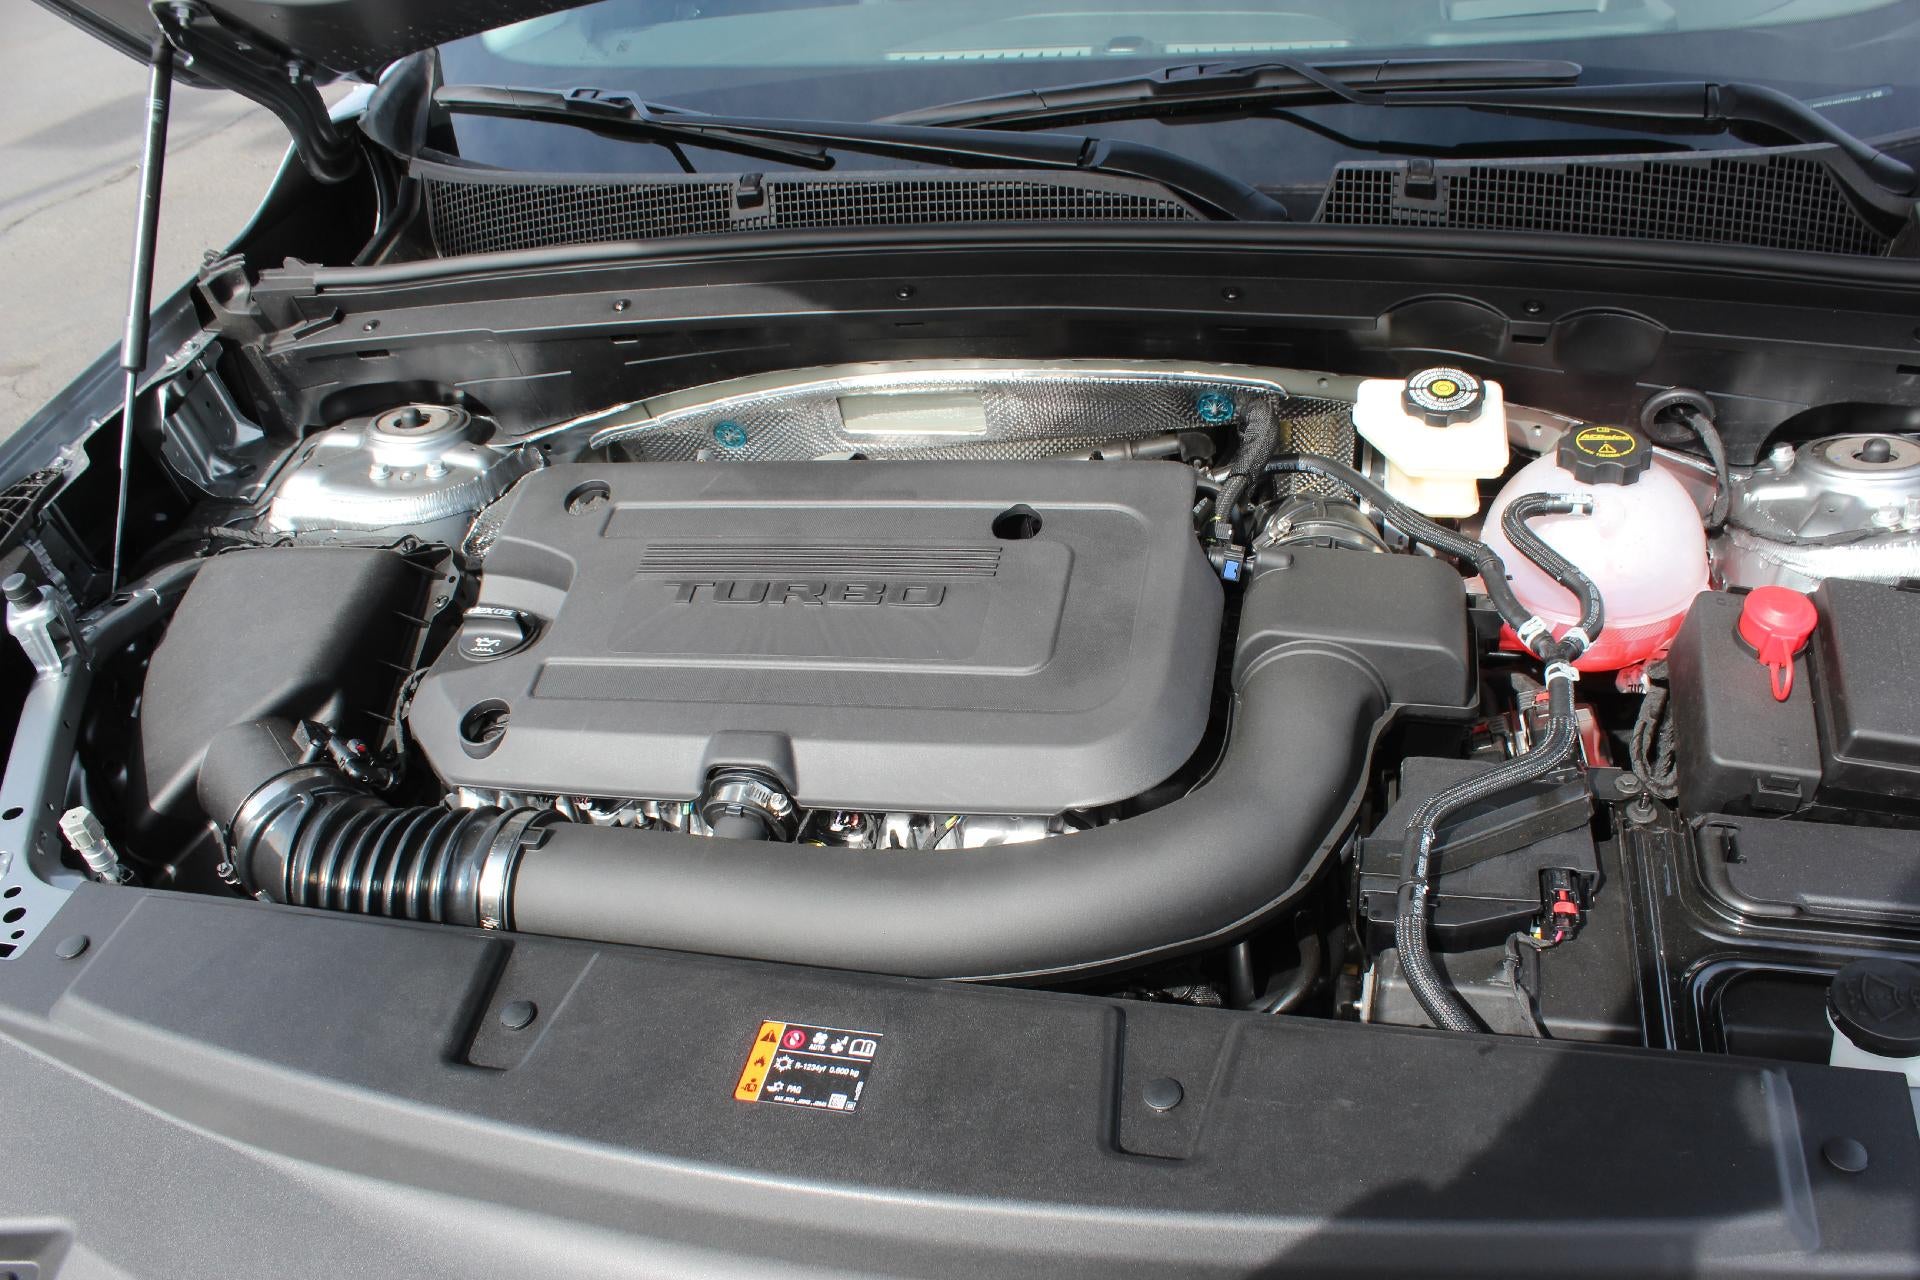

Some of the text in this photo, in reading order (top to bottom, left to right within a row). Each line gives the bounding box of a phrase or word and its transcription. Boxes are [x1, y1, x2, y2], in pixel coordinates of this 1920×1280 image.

[663, 580, 947, 608] TURBO
[467, 606, 516, 616] dexos
[809, 1043, 826, 1051] AUTO
[794, 1061, 826, 1073] R-1234yf
[850, 1068, 859, 1077] kg
